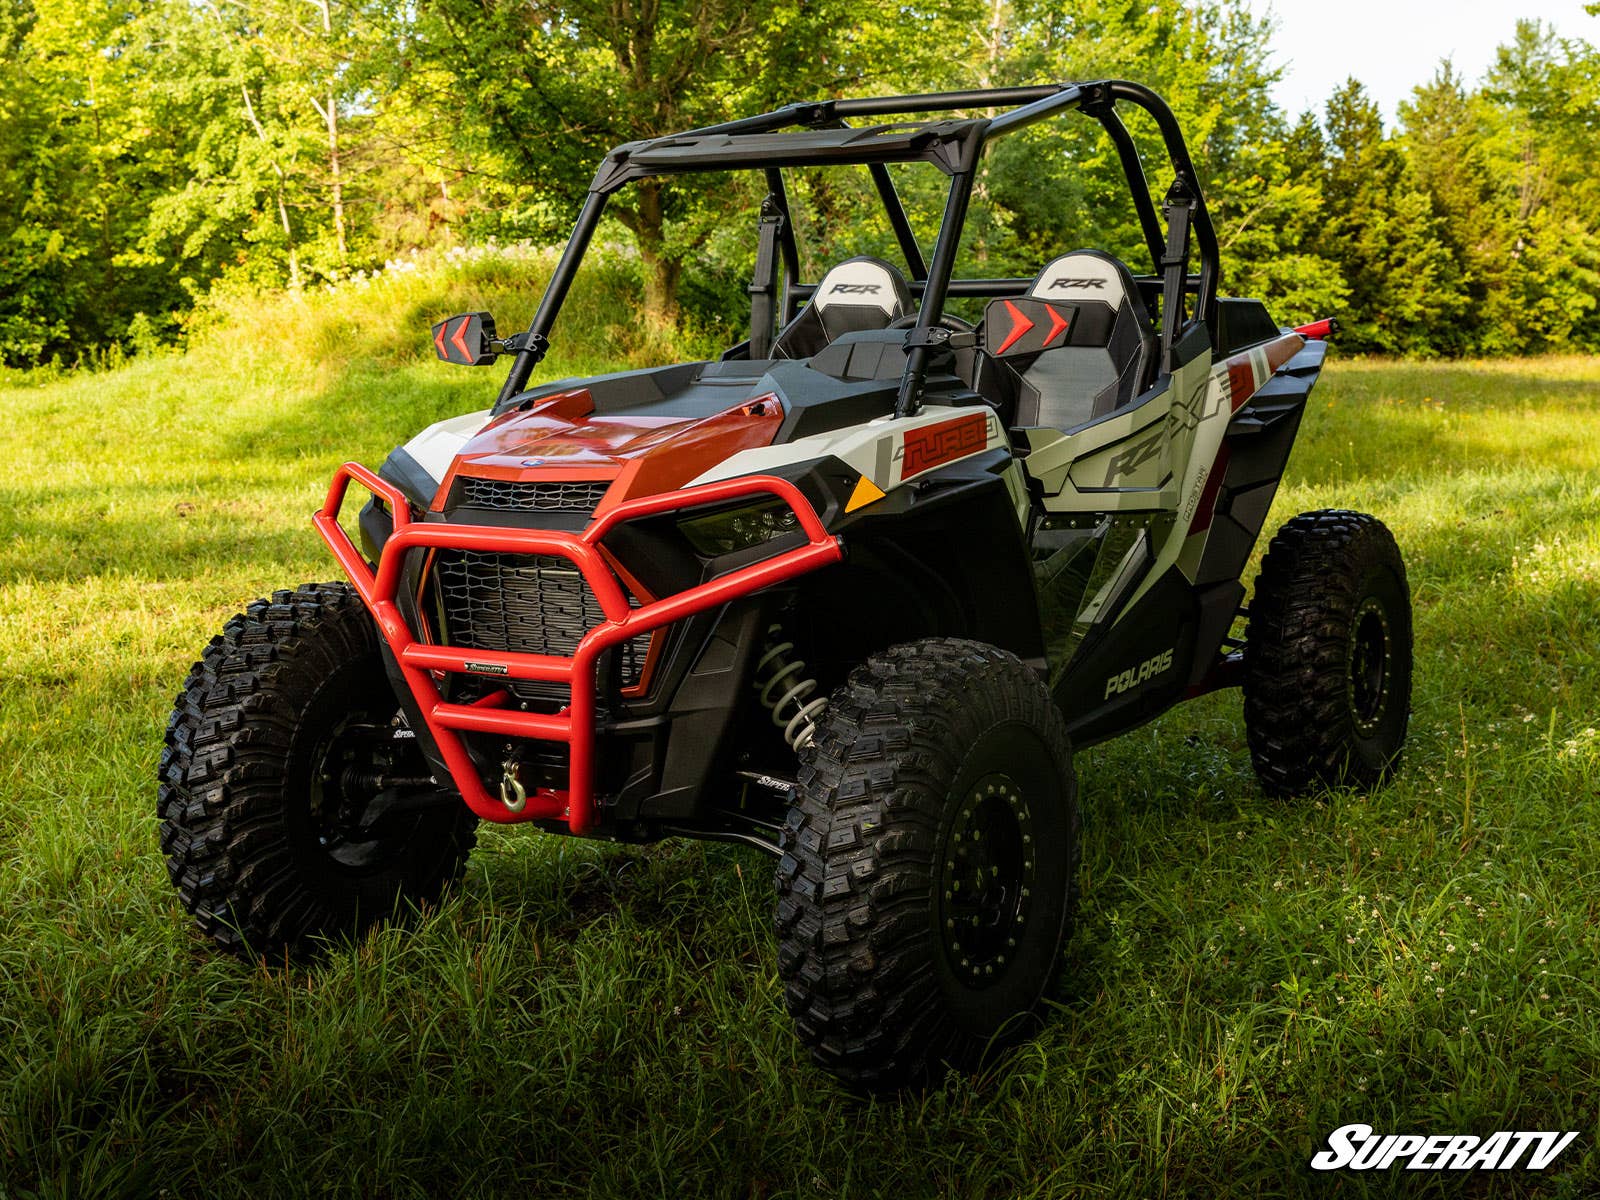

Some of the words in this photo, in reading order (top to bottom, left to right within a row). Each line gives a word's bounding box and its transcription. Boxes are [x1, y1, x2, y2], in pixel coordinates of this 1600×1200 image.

[829, 284, 882, 295] RZR
[1048, 278, 1107, 290] RZR
[893, 414, 999, 471] TURBO
[1104, 648, 1174, 700] POLARIS
